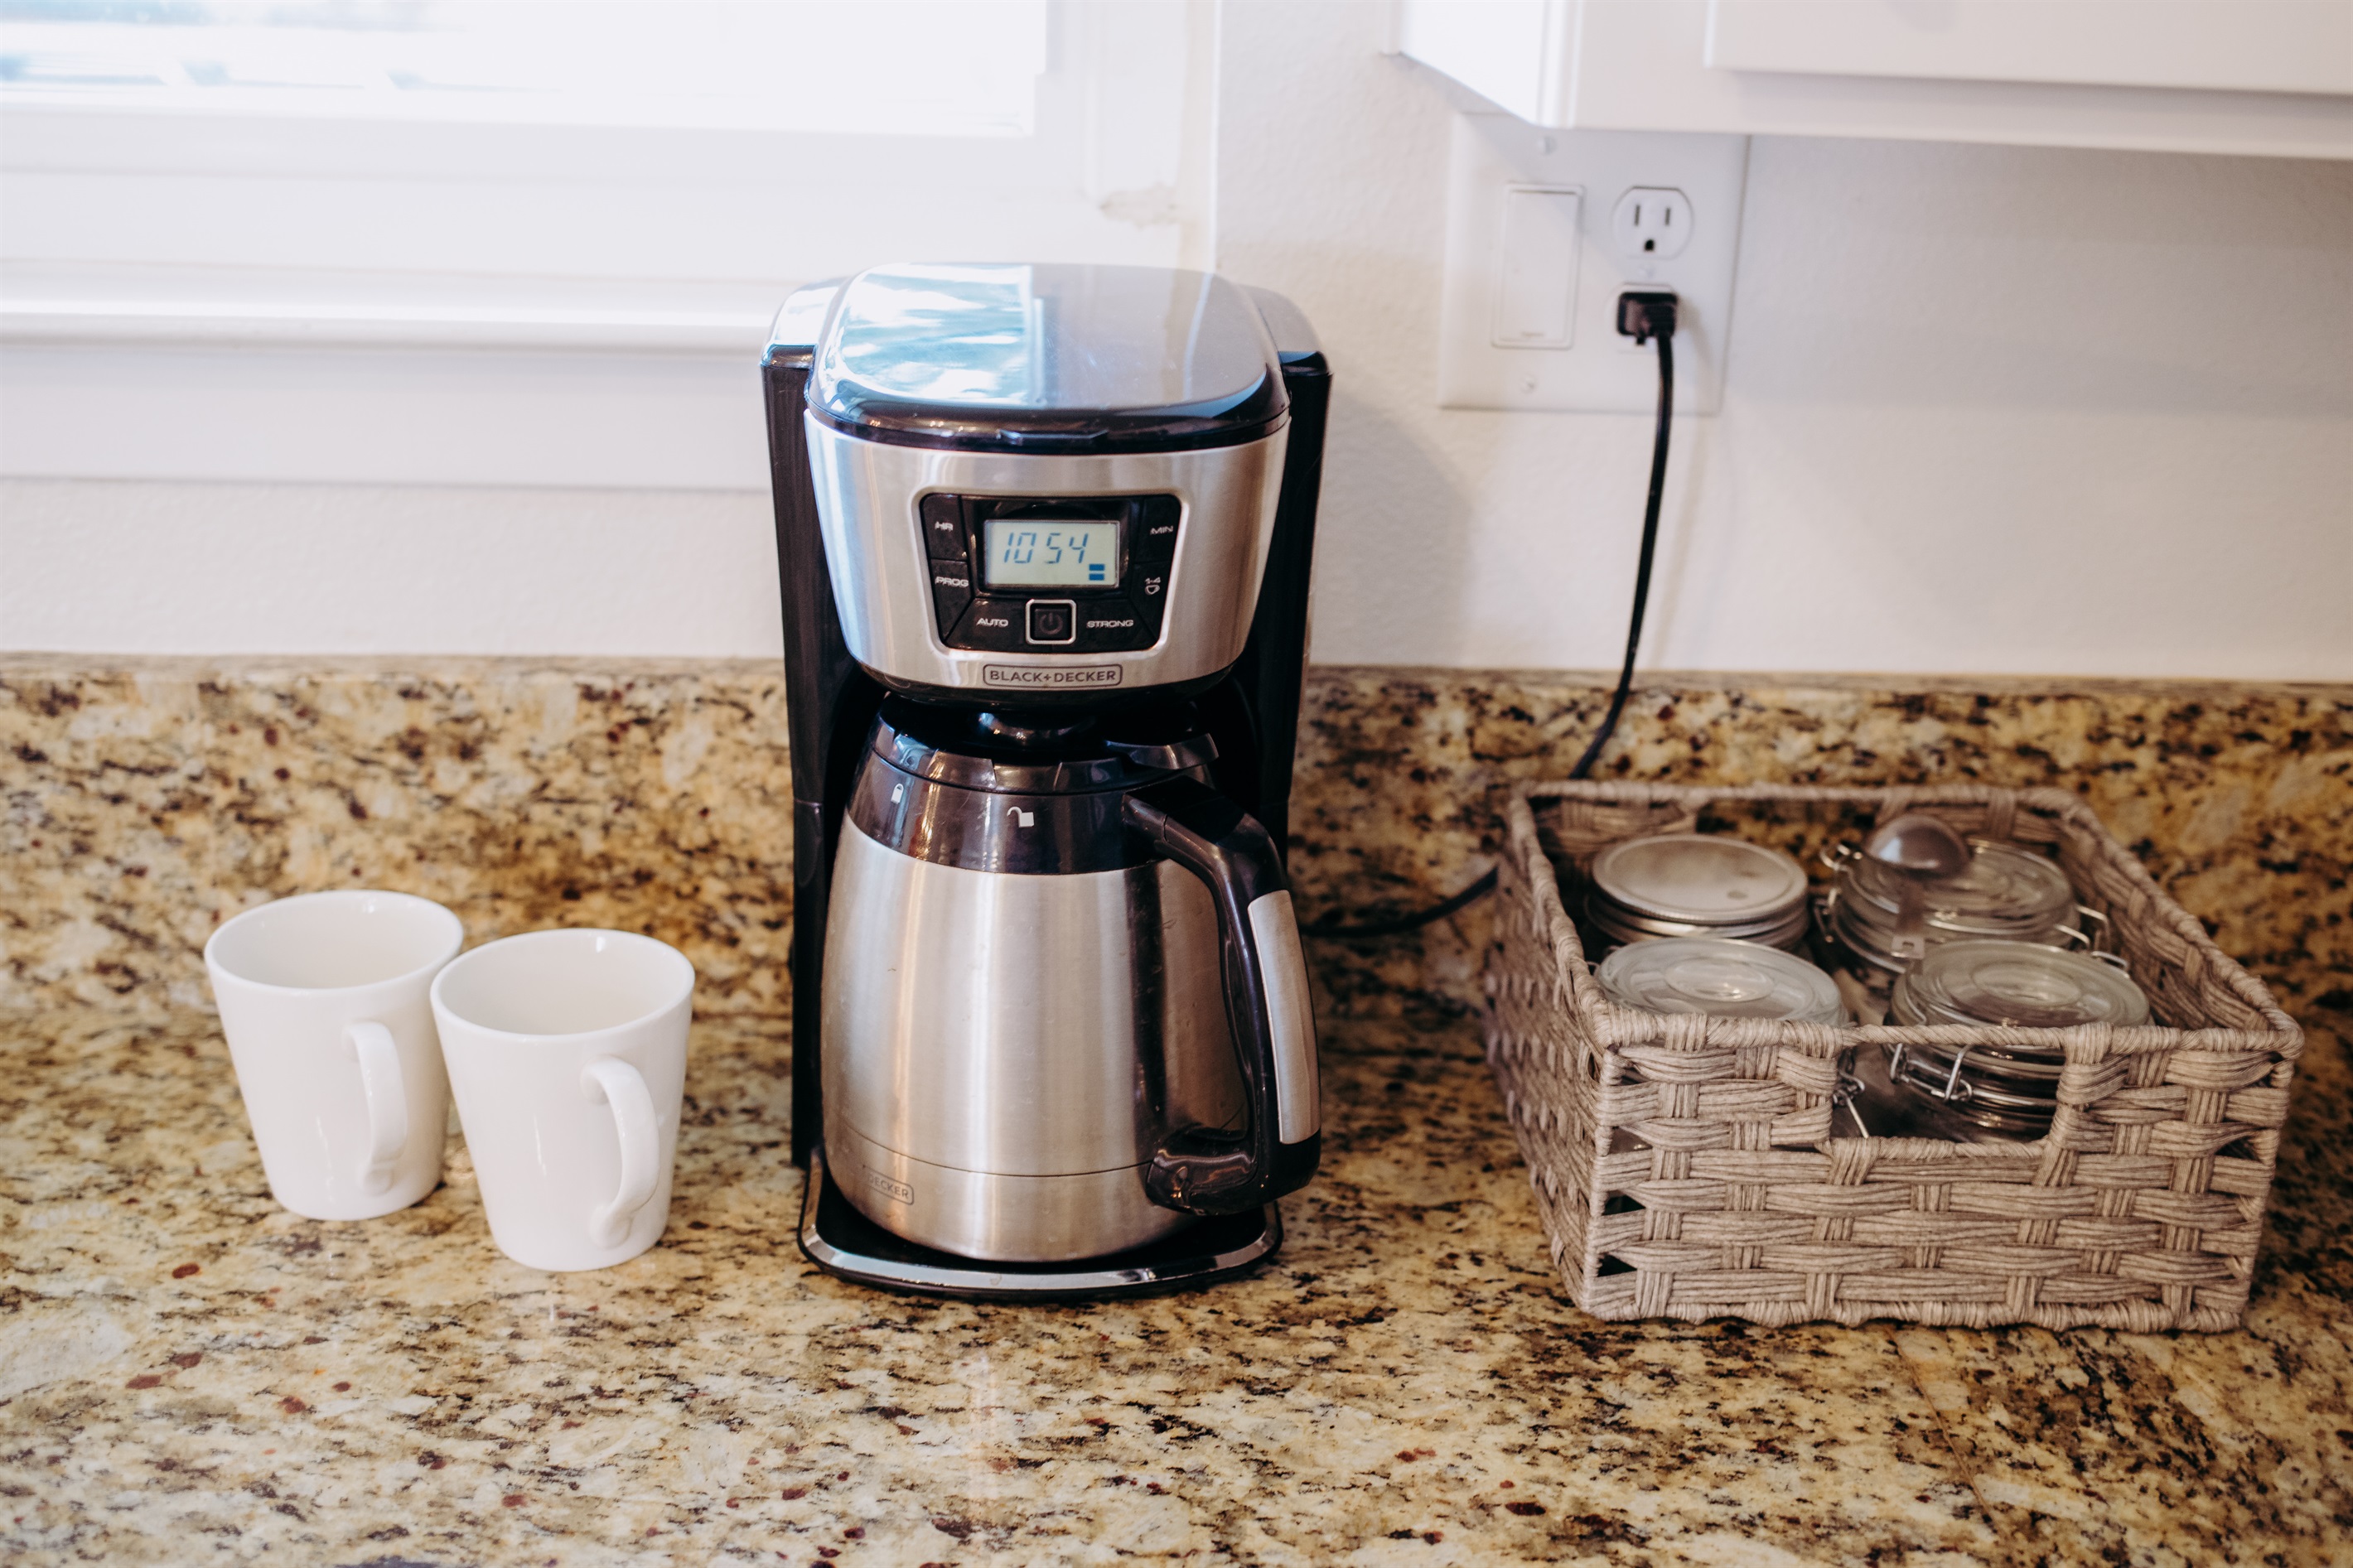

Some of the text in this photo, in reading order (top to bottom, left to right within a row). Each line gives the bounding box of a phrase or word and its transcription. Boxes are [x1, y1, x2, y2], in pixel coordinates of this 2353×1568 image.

[935, 521, 954, 532] HR
[1150, 524, 1174, 535] MIN
[935, 576, 969, 588] PROG
[976, 617, 1009, 628] AUTO
[1086, 620, 1134, 629] STRONG
[989, 670, 1116, 683] BLACK+DECKER
